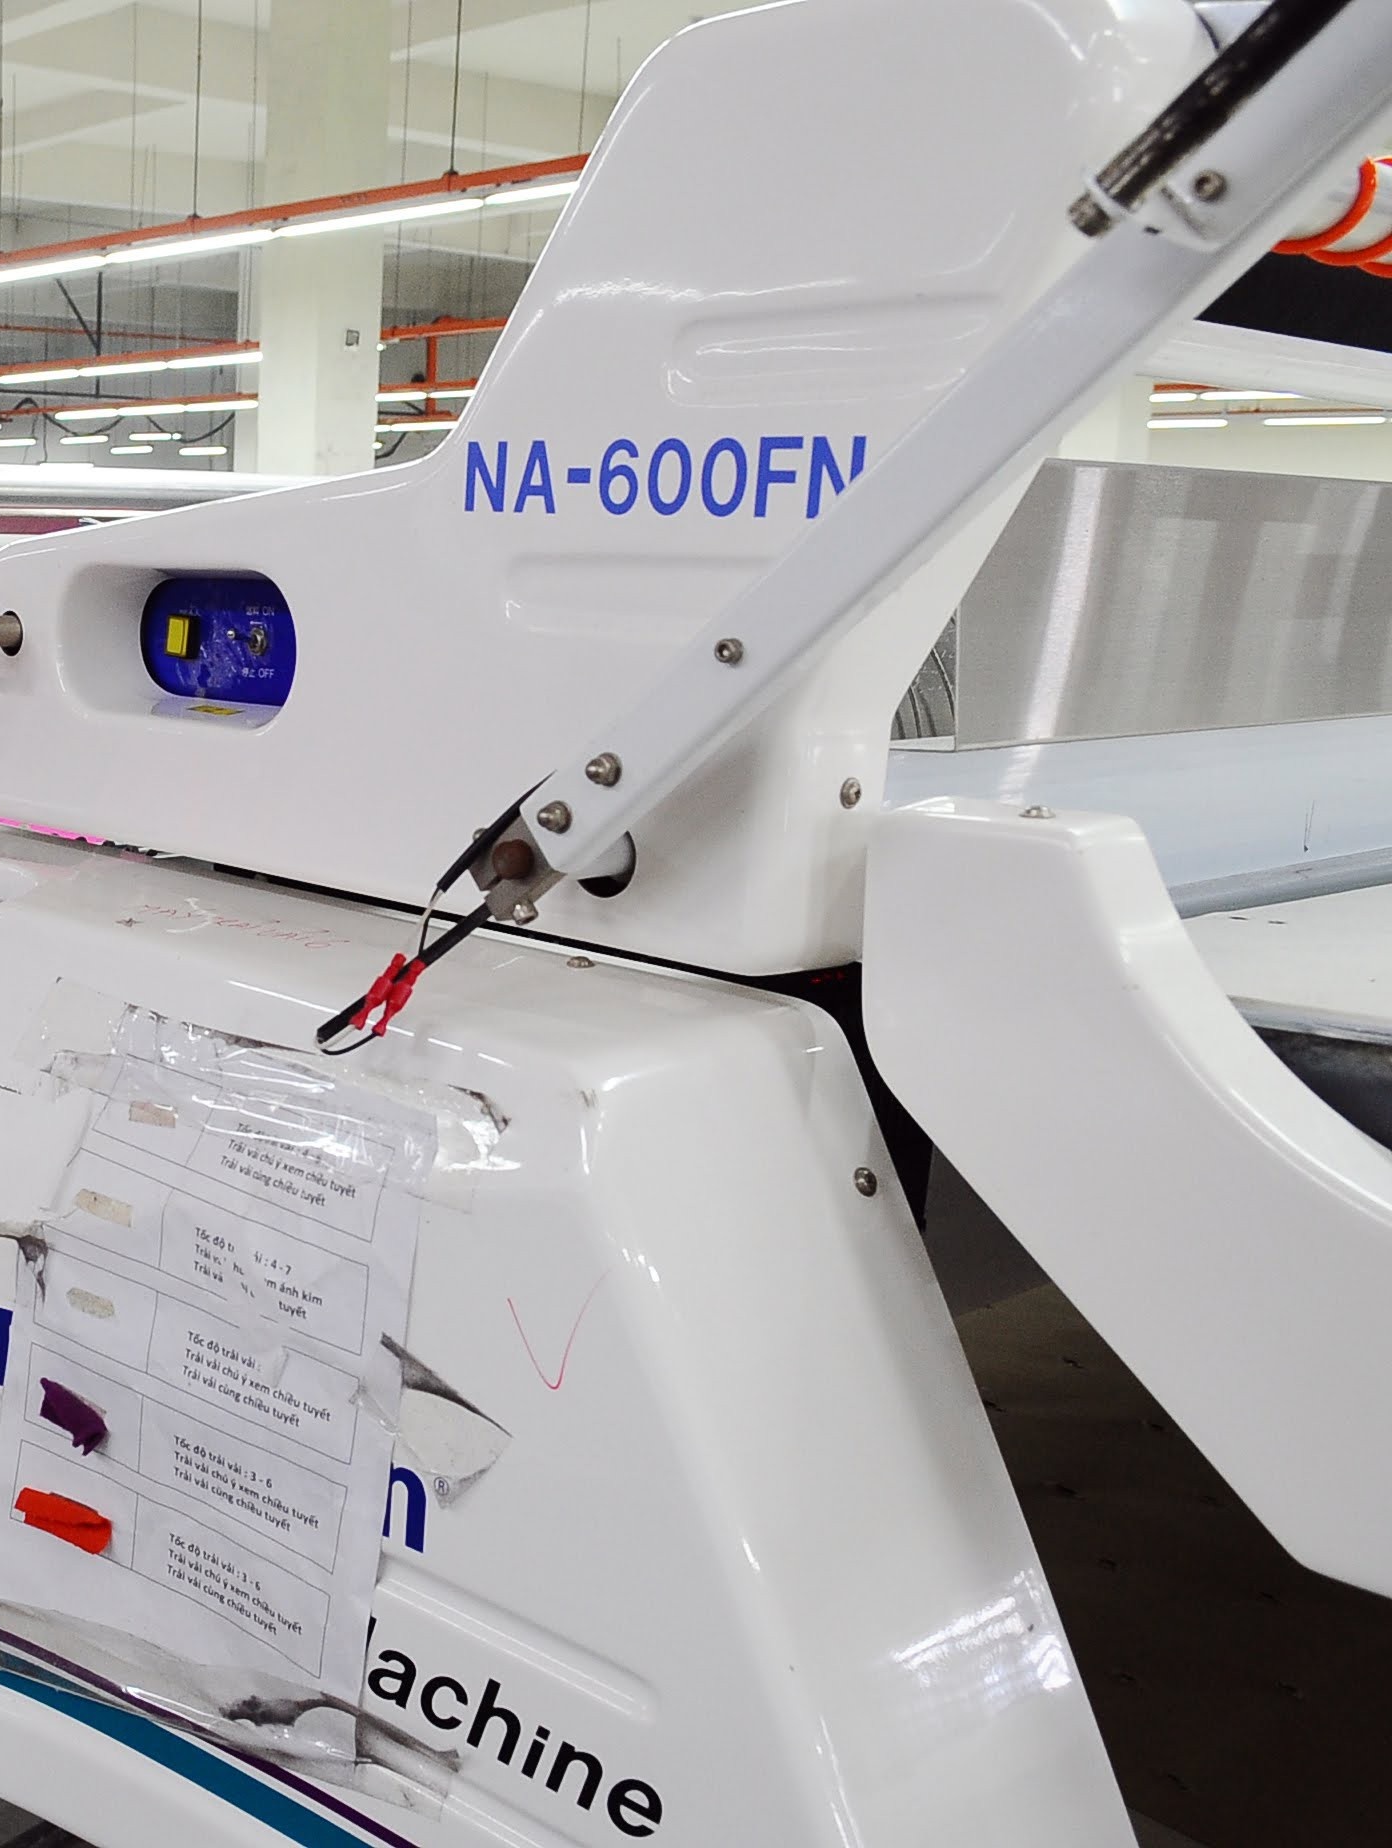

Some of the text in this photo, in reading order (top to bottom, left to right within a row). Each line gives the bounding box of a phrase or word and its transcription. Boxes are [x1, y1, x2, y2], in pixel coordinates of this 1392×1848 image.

[464, 436, 867, 519] NA-600FN
[258, 667, 275, 679] OFF
[282, 1162, 305, 1178] xem
[285, 1265, 292, 1275] 7
[302, 1290, 323, 1306] kim
[188, 1331, 205, 1347] Tốc
[250, 1379, 270, 1395] xem
[174, 1435, 191, 1451] Tốc
[251, 1471, 257, 1482] 3
[266, 1478, 272, 1489] 6
[239, 1484, 260, 1499] xem
[169, 1533, 186, 1549] Tốc
[230, 1585, 250, 1601] xem
[366, 1616, 663, 1838] achine
